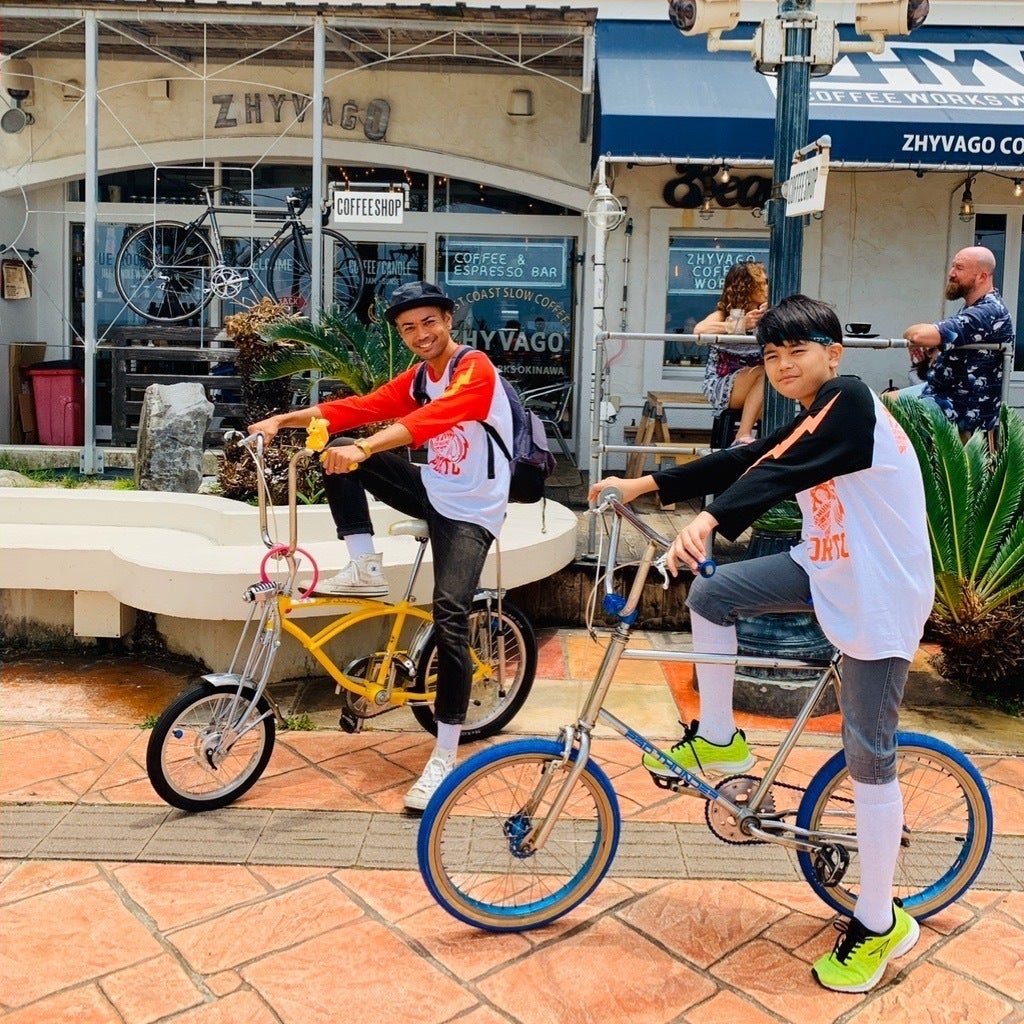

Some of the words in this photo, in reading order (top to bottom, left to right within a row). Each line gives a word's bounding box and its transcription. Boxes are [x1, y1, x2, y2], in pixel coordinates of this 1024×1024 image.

[904, 93, 1003, 106] WORKS
[212, 92, 391, 141] ZHYVAGO
[902, 134, 996, 154] ZHYVAGO
[454, 252, 507, 265] COFFEE
[517, 254, 525, 265] &
[687, 253, 756, 265] ZHYVAGO
[454, 265, 523, 277] ESPRESSO
[531, 267, 558, 277] BAR
[692, 265, 730, 277] COFF
[466, 287, 502, 303] COAST
[503, 288, 534, 302] SLOW
[534, 294, 571, 324] COFFEE
[449, 329, 564, 353] ZHYVAGO
